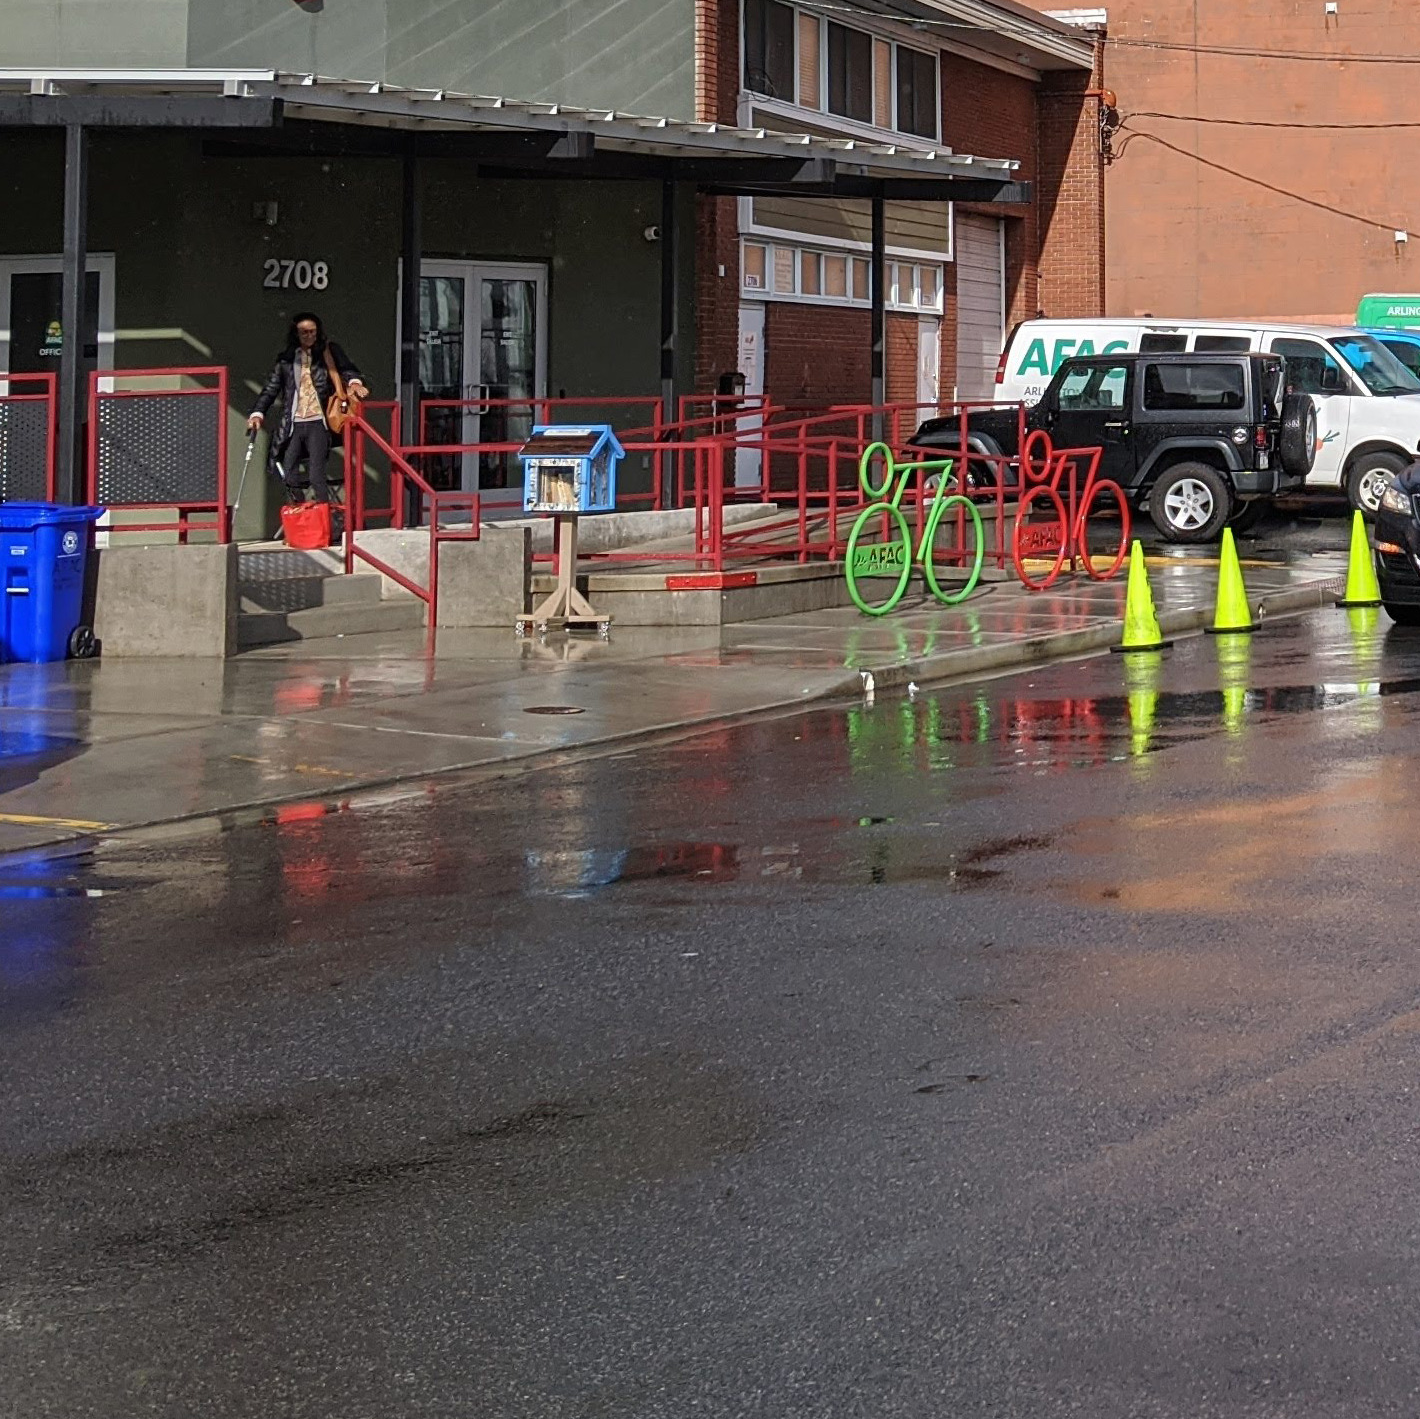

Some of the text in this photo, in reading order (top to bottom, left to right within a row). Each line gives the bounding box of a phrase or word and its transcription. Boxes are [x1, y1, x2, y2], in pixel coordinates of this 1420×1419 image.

[263, 258, 328, 290] 2708
[39, 348, 62, 356] OFFIC
[868, 545, 904, 571] AFAC
